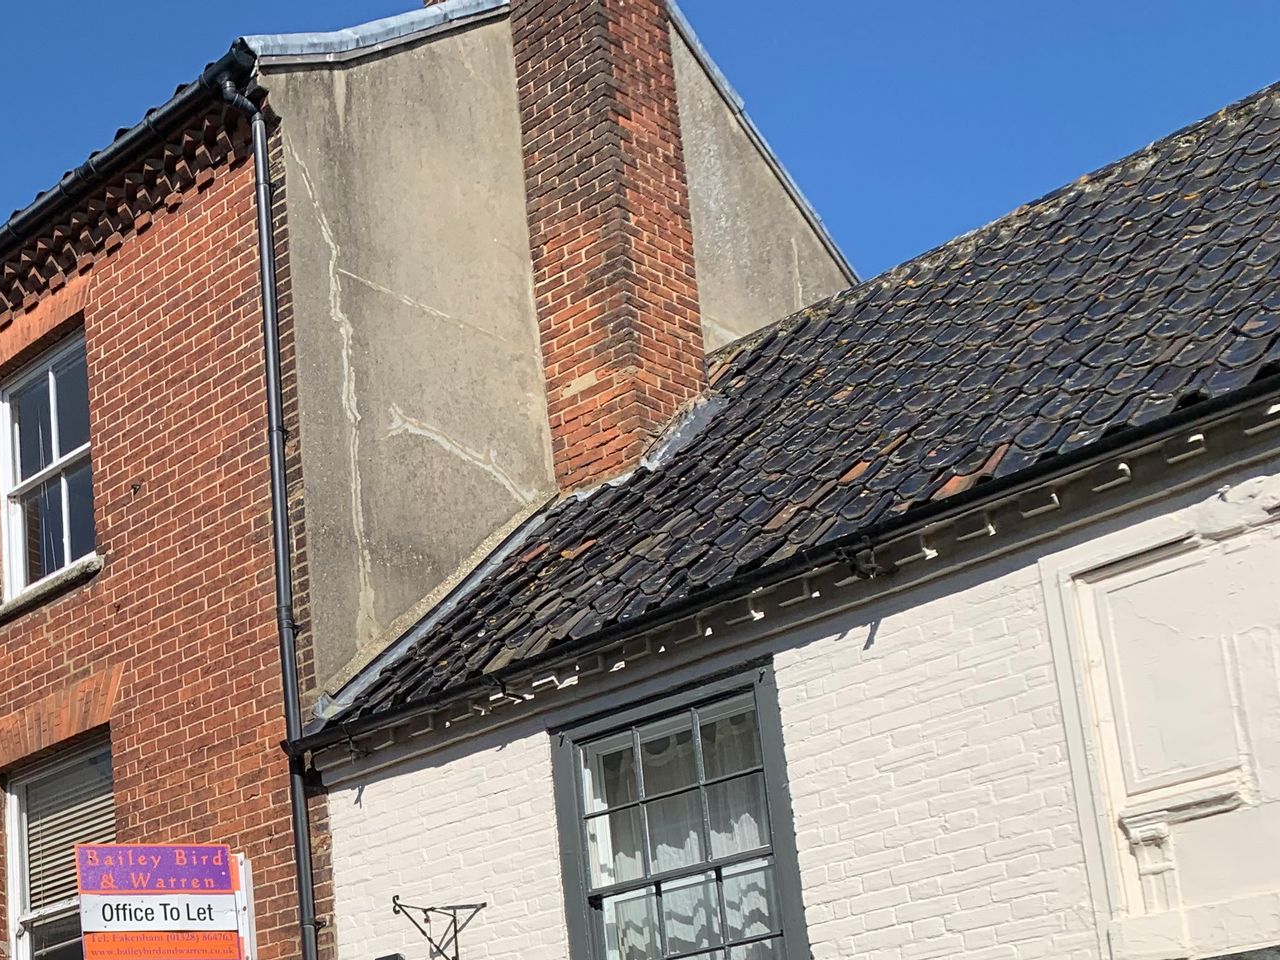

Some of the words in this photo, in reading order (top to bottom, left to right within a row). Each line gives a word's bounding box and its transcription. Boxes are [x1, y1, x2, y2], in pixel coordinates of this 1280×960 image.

[86, 849, 162, 869] Bailey
[175, 849, 224, 866] Bird
[100, 873, 116, 889] &
[130, 872, 215, 889] Warren
[101, 903, 155, 922] Office
[159, 903, 181, 921] To
[186, 903, 215, 922] Let
[91, 933, 110, 943] Tel:
[112, 933, 164, 942] Fakenham
